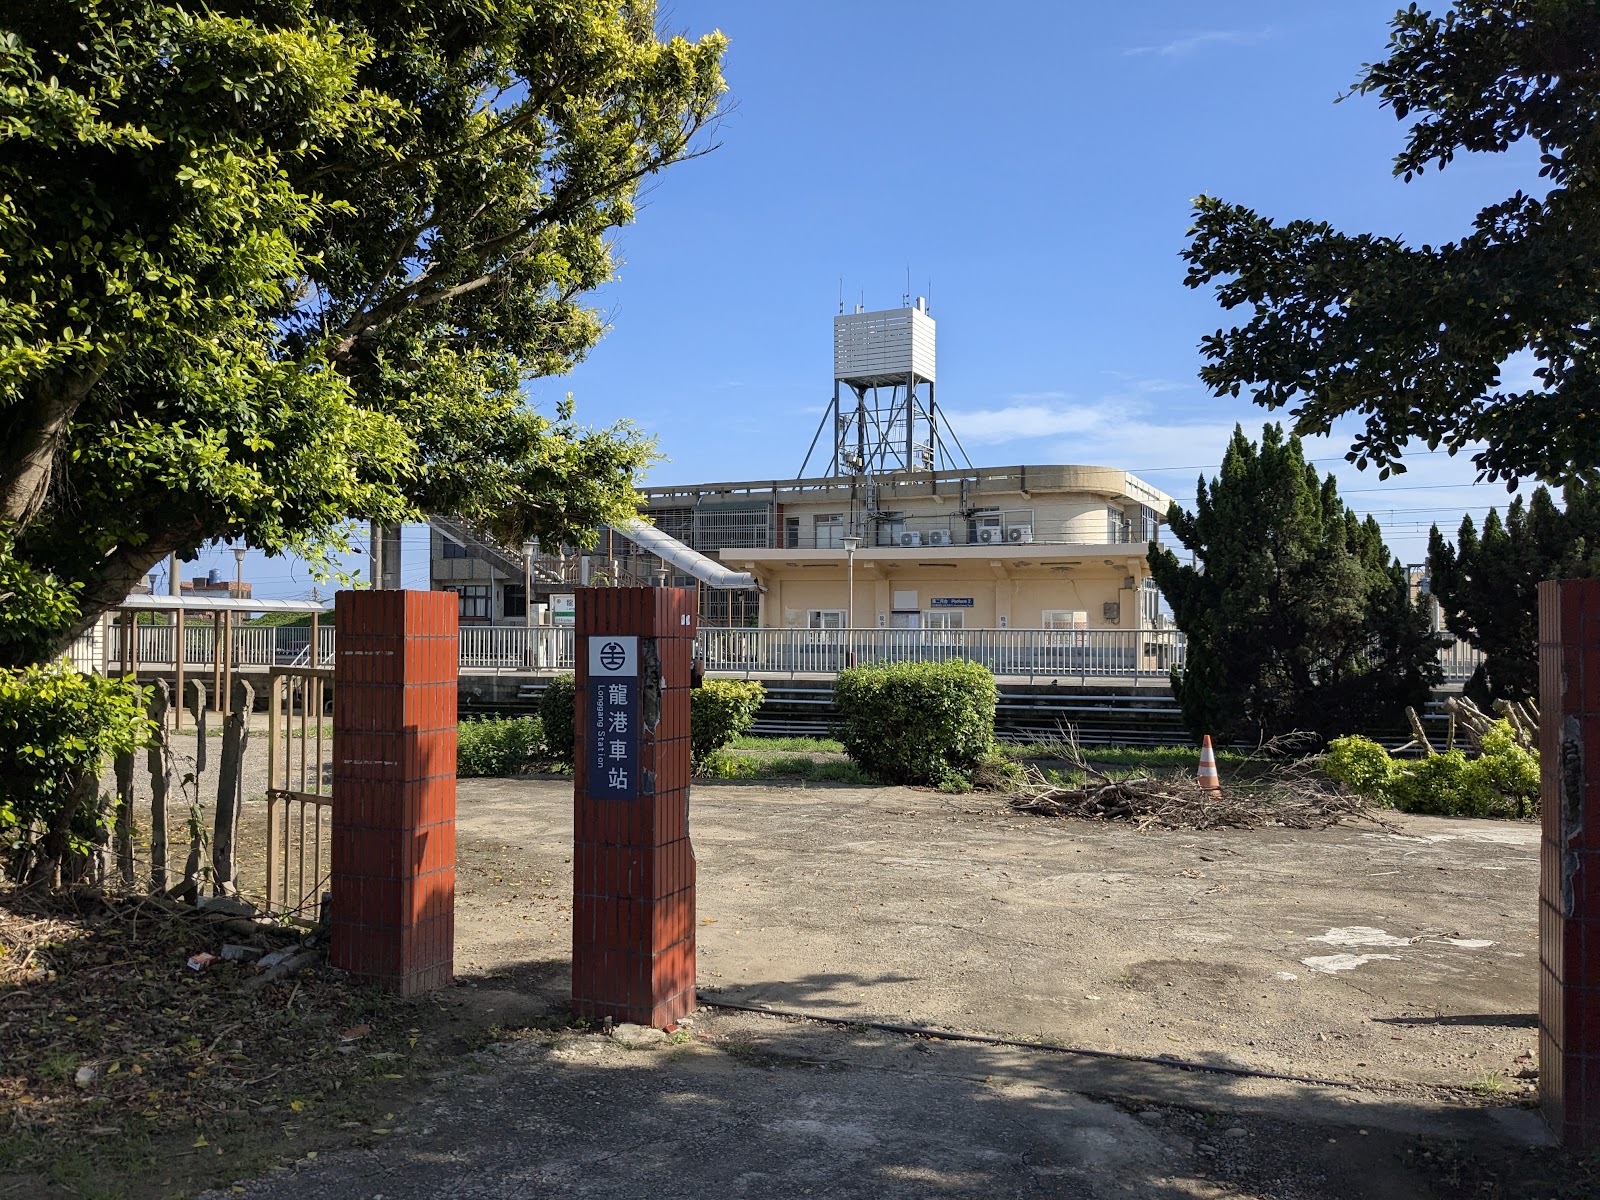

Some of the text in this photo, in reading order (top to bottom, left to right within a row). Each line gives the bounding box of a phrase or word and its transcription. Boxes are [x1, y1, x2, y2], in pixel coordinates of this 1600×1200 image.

[597, 684, 606, 768] Longgang Station
[608, 683, 628, 790] 龍港車站
